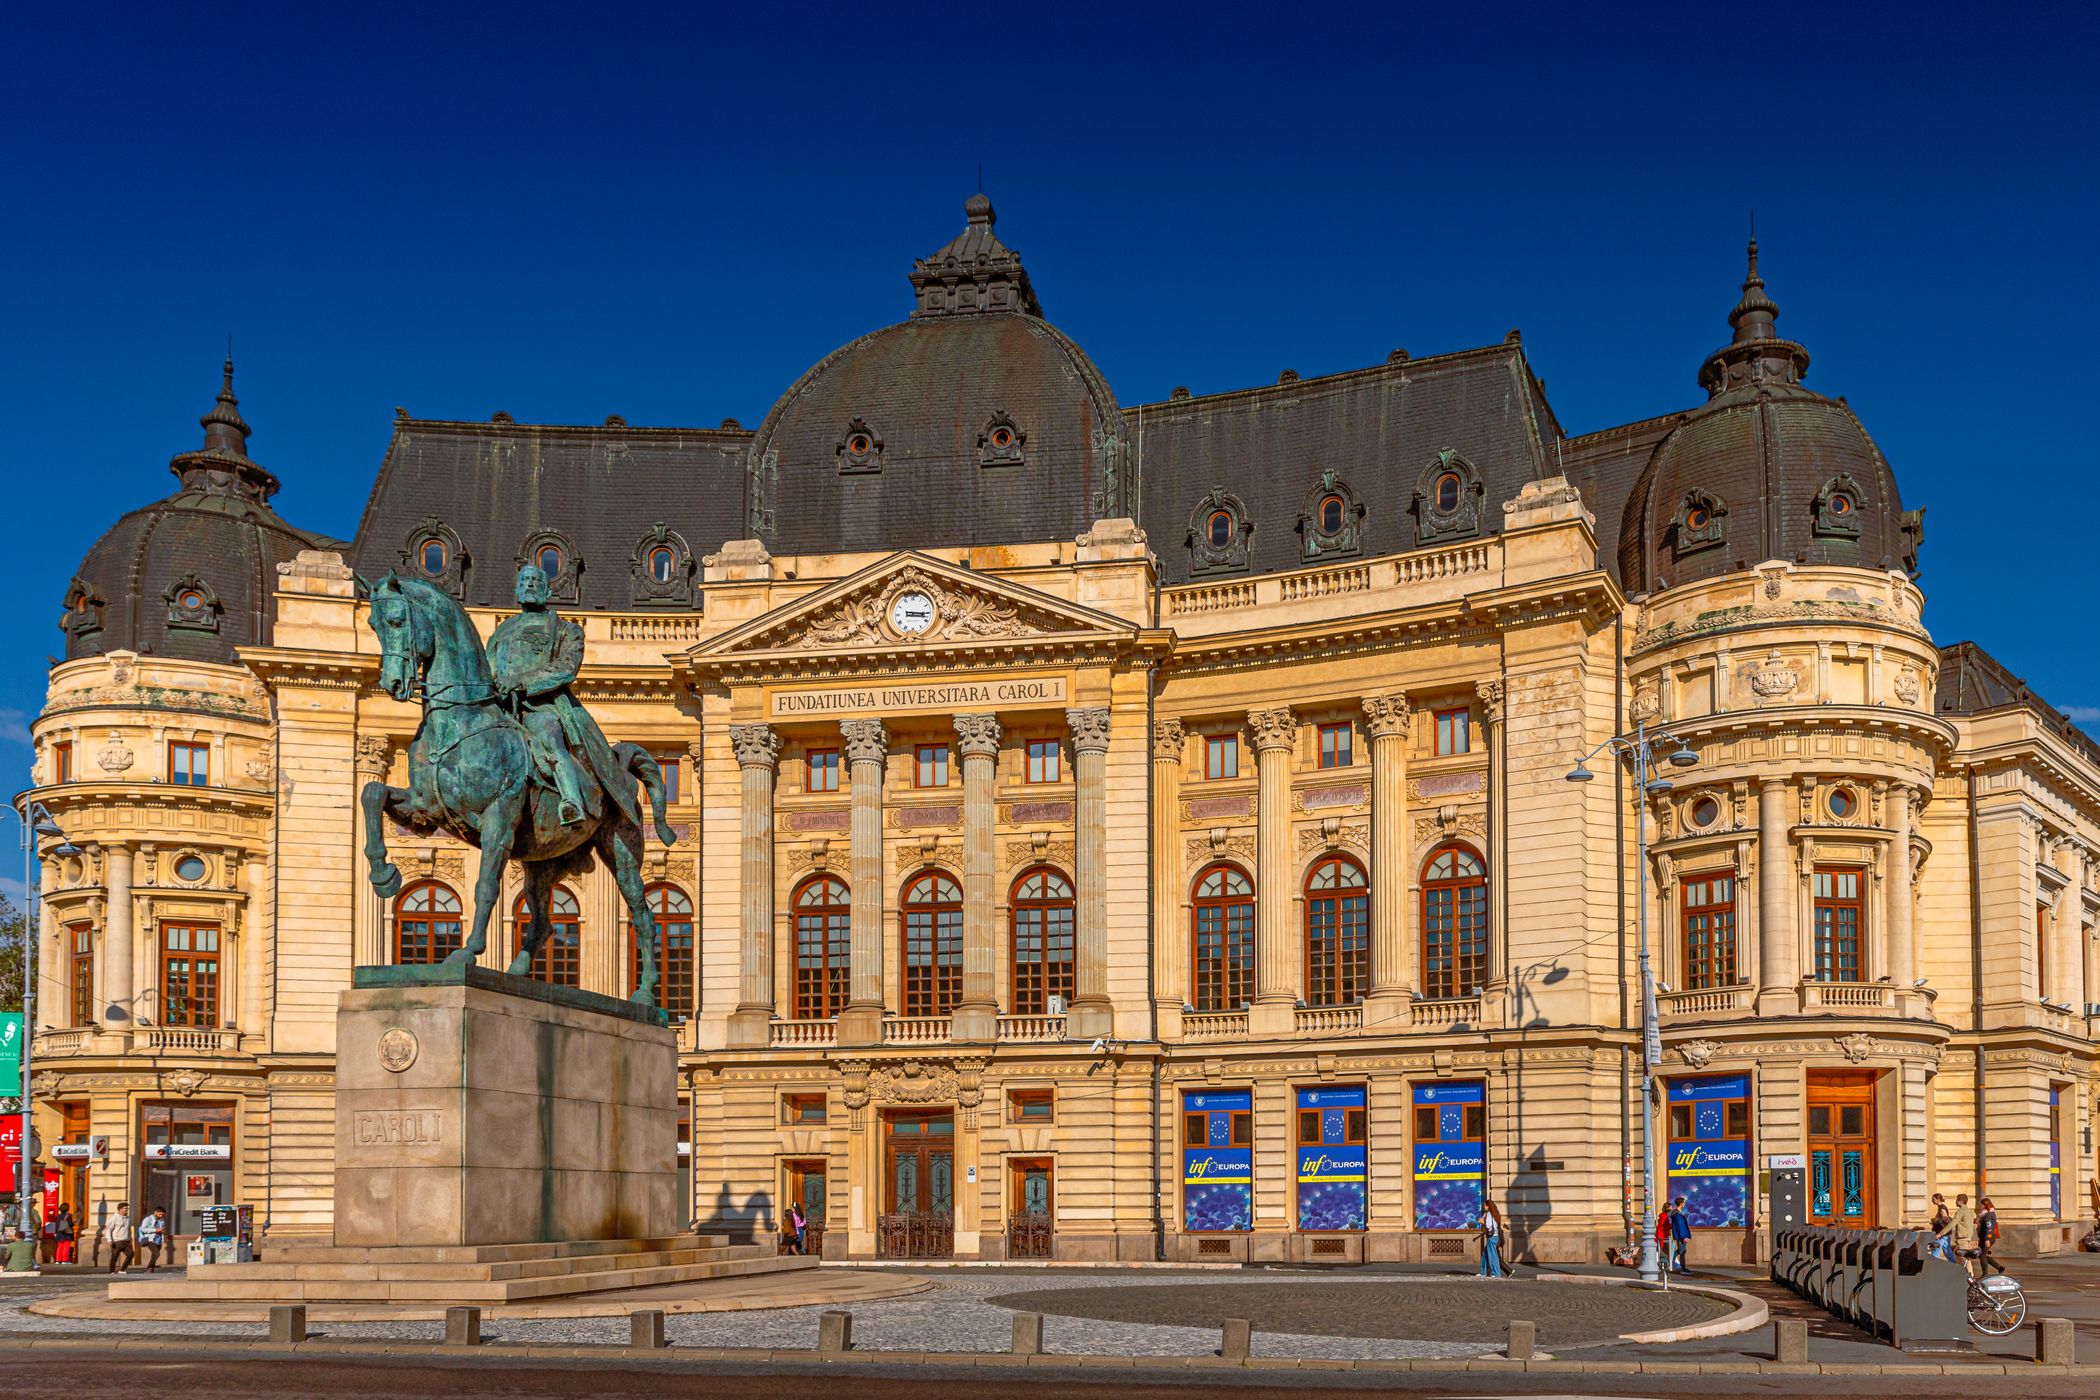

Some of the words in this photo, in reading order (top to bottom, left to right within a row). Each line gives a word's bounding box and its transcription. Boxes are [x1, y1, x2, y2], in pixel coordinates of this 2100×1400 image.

[778, 692, 876, 711] FUNDATIUNEA
[882, 686, 990, 706] UNIVERSITARA
[997, 683, 1049, 700] CAROL
[1054, 682, 1060, 697] I
[166, 1148, 199, 1156] UniCredit
[200, 1148, 219, 1156] Bank
